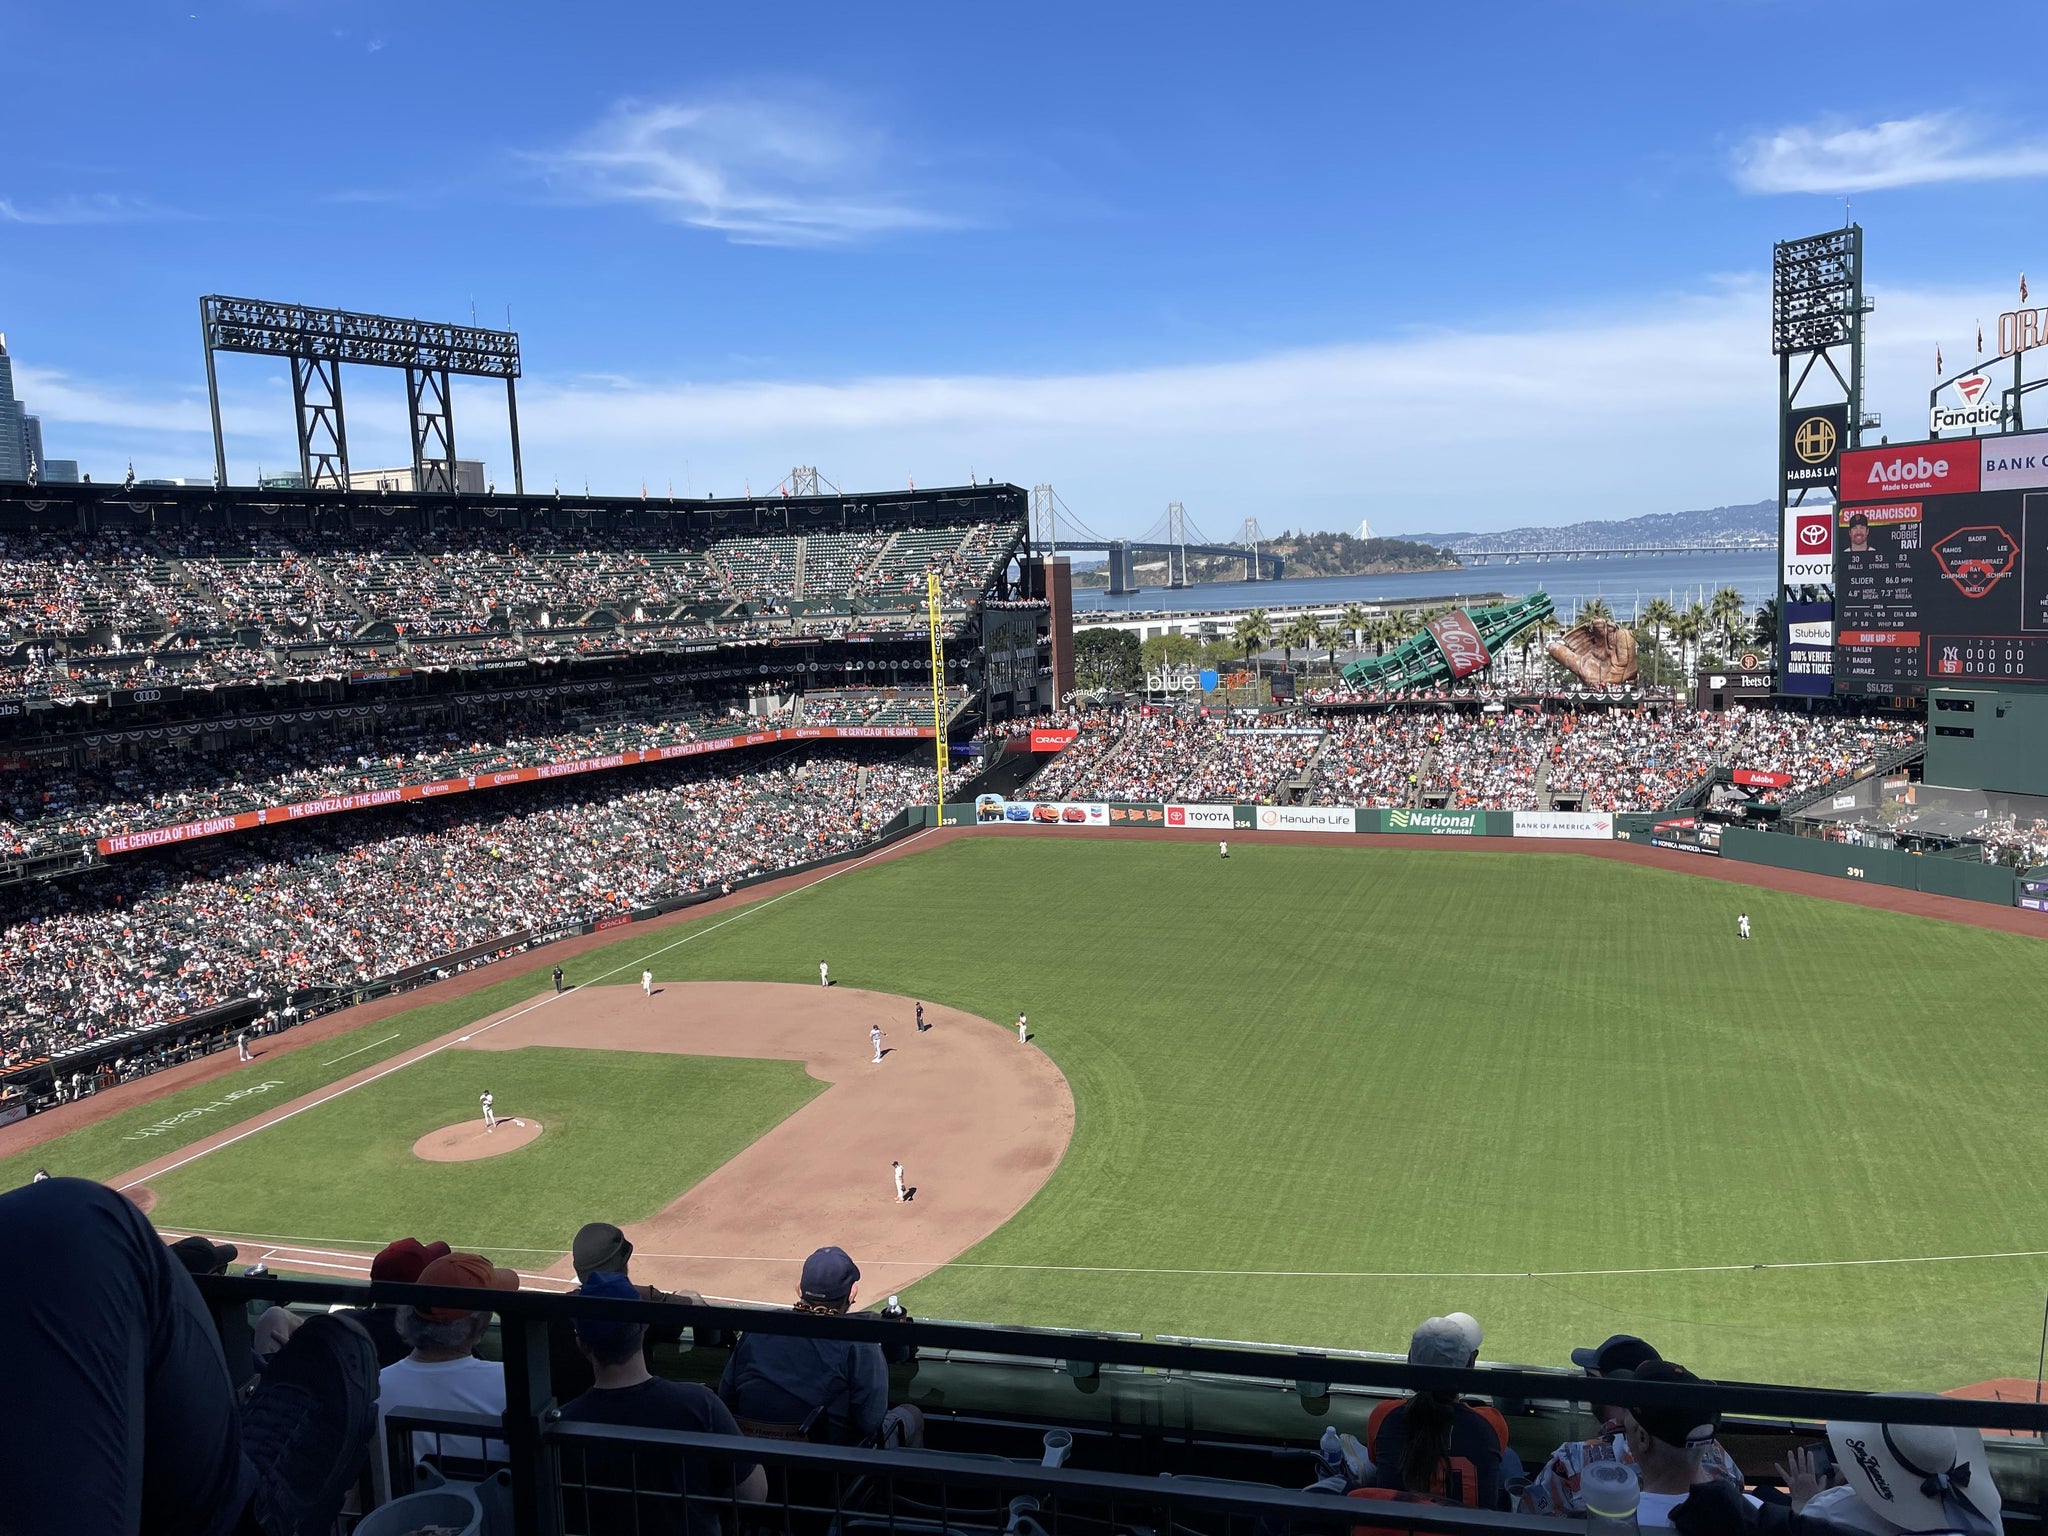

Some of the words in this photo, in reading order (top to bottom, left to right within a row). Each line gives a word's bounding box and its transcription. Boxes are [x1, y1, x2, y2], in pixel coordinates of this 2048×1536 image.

[1933, 406, 2003, 427] Fanatic
[1986, 456, 2035, 471] BANK
[1787, 468, 1822, 480] HABBAS
[1867, 457, 1949, 483] Adobe
[1909, 481, 1932, 489] create.
[1864, 507, 1917, 520] FRANCISCO
[1891, 531, 1918, 540] ROBBIE
[1900, 540, 1918, 550] RAY
[1850, 577, 1874, 585] SLIDER
[1885, 576, 1899, 584] 86.0
[1795, 628, 1831, 638] StubHub
[1860, 634, 1875, 643] DUE
[1875, 634, 1886, 643] UP
[1887, 634, 1897, 643] SF
[1790, 651, 1807, 662] 100%
[1966, 648, 1973, 660] 0
[1977, 649, 1984, 660] 0
[1988, 649, 1996, 660] 0
[2005, 649, 2012, 660] 0
[2016, 649, 2024, 661] 0
[506, 660, 527, 668] MINOLTA
[936, 660, 942, 669] 4
[1788, 663, 1811, 674] GIANTS
[1812, 663, 1834, 675] TICKET
[1966, 662, 1973, 673] 0
[1977, 662, 1984, 673] 0
[1988, 662, 1995, 673] 0
[2005, 663, 2012, 674] 0
[2016, 663, 2024, 674] 0
[1907, 669, 1918, 677] 0-2
[1866, 682, 1893, 693] $51,725
[1061, 688, 1106, 704] Ghirardelli
[796, 729, 820, 737] Corona
[836, 727, 848, 736] THE
[848, 727, 875, 736] CERVEZA
[875, 727, 883, 736] OF
[884, 727, 895, 736] THE
[896, 727, 918, 736] GIANTS
[660, 747, 672, 758] THE
[672, 744, 696, 756] CERVEZA
[696, 743, 703, 753] OF
[704, 740, 715, 750] THE
[715, 738, 734, 750] GIANTS
[537, 766, 550, 778] THE
[550, 762, 580, 776] CERVEZA
[580, 760, 588, 770] OF
[589, 758, 601, 769] THE
[601, 754, 624, 767] GIANTS
[494, 773, 519, 784] Corona
[1750, 774, 1774, 785] Adobe
[421, 785, 449, 796] Corona
[288, 805, 304, 818] THE
[305, 799, 342, 814] CERVEZA
[342, 796, 353, 809] OF
[355, 793, 371, 807] THE
[372, 789, 401, 804] GIANTS
[942, 817, 958, 826] 339
[1189, 812, 1230, 821] TOYOTA
[1279, 814, 1326, 824] Hanwha
[1328, 815, 1350, 825] Life
[1409, 813, 1475, 827] National
[108, 838, 129, 852] THE
[129, 831, 172, 848] CERVEZA
[172, 827, 184, 839] OF
[185, 822, 203, 837] THE
[203, 817, 236, 834] GIANTS
[1616, 831, 1630, 840] 399
[1658, 840, 1678, 849] KONICA
[1677, 843, 1701, 853] MINOLTA
[1847, 866, 1865, 878] 391
[600, 917, 627, 929] ORACLE
[1846, 1438, 1867, 1461] San
[1862, 1455, 1894, 1503] Francisco
